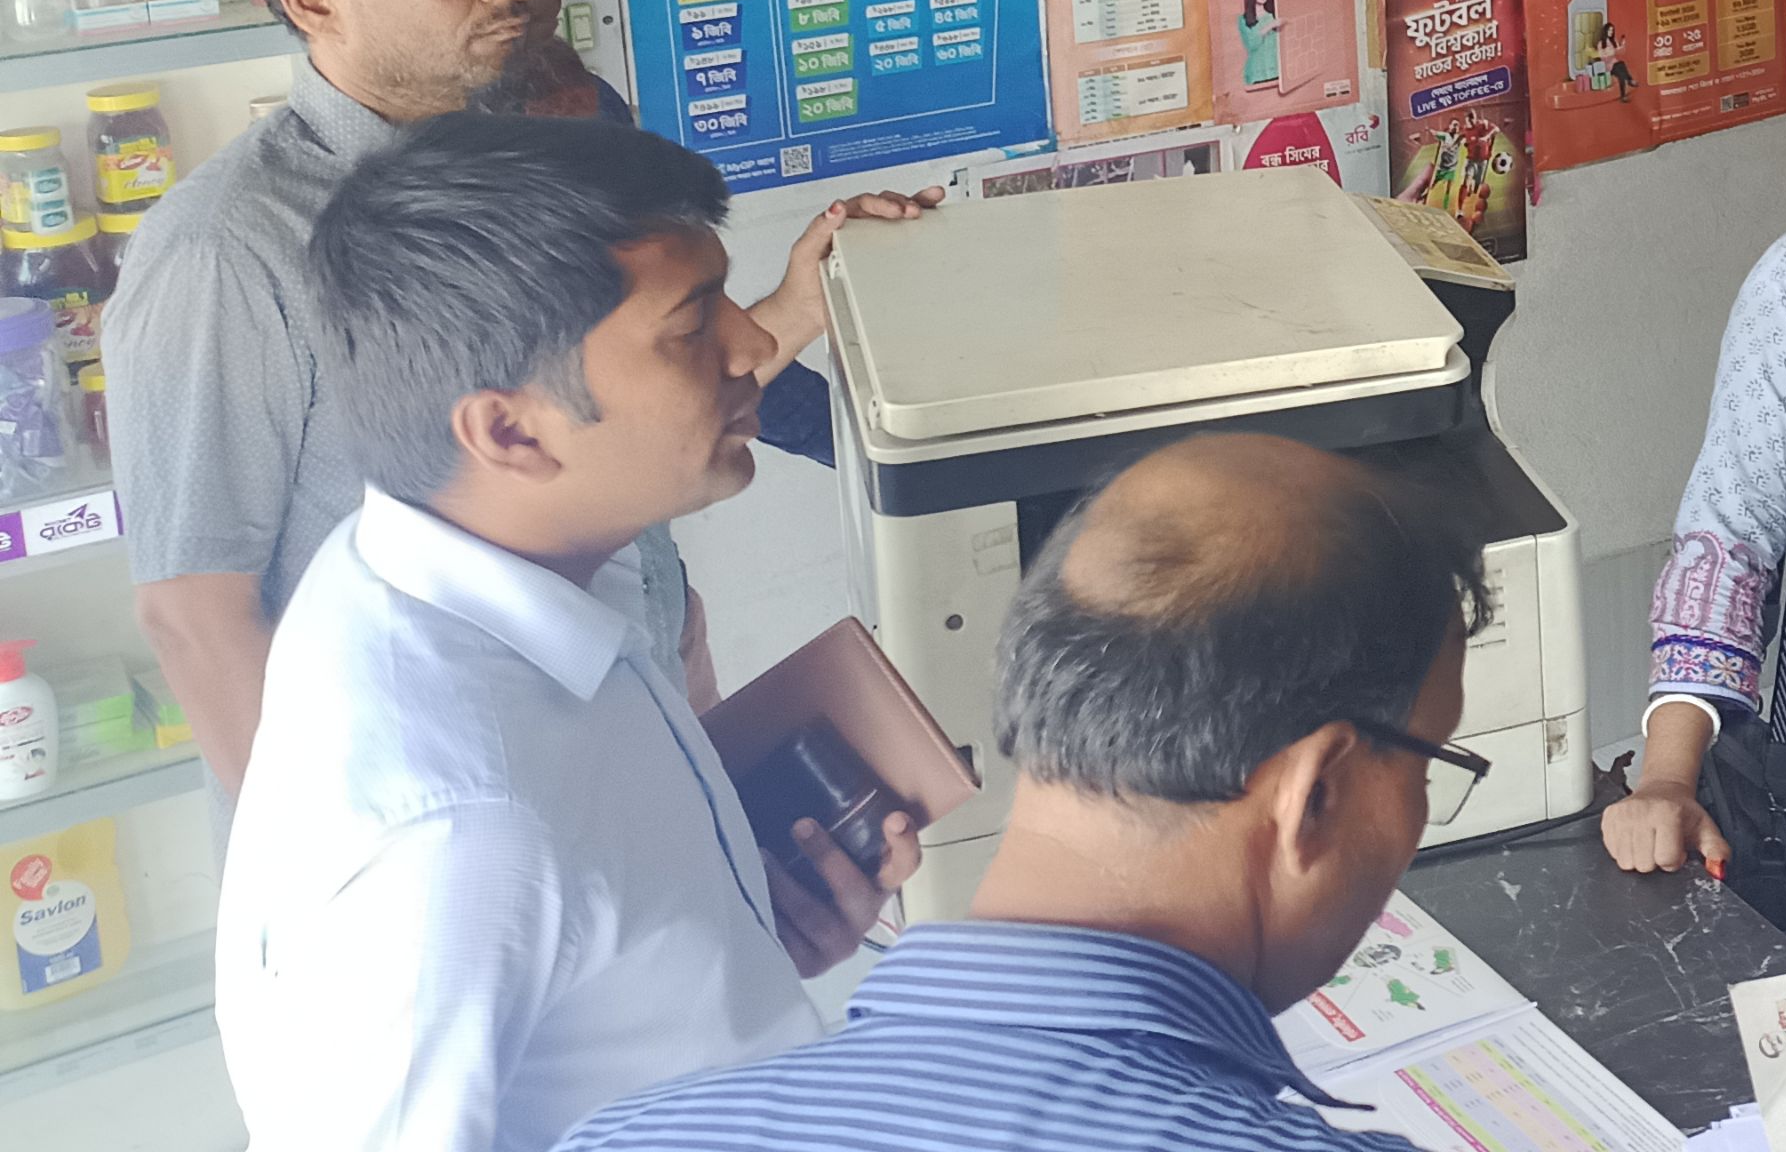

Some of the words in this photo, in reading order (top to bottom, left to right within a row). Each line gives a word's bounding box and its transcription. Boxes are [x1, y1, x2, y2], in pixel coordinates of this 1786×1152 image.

[1427, 20, 1498, 58] বিশ্বকাপ
[1414, 56, 1452, 80] হাতের
[1455, 42, 1502, 70] মুঠোয়!
[1417, 99, 1437, 114] LIVE
[1345, 124, 1369, 145] রবি
[1260, 152, 1282, 167] বন্ধ
[1284, 144, 1320, 163] সিমের
[19, 894, 87, 926] Savlon
